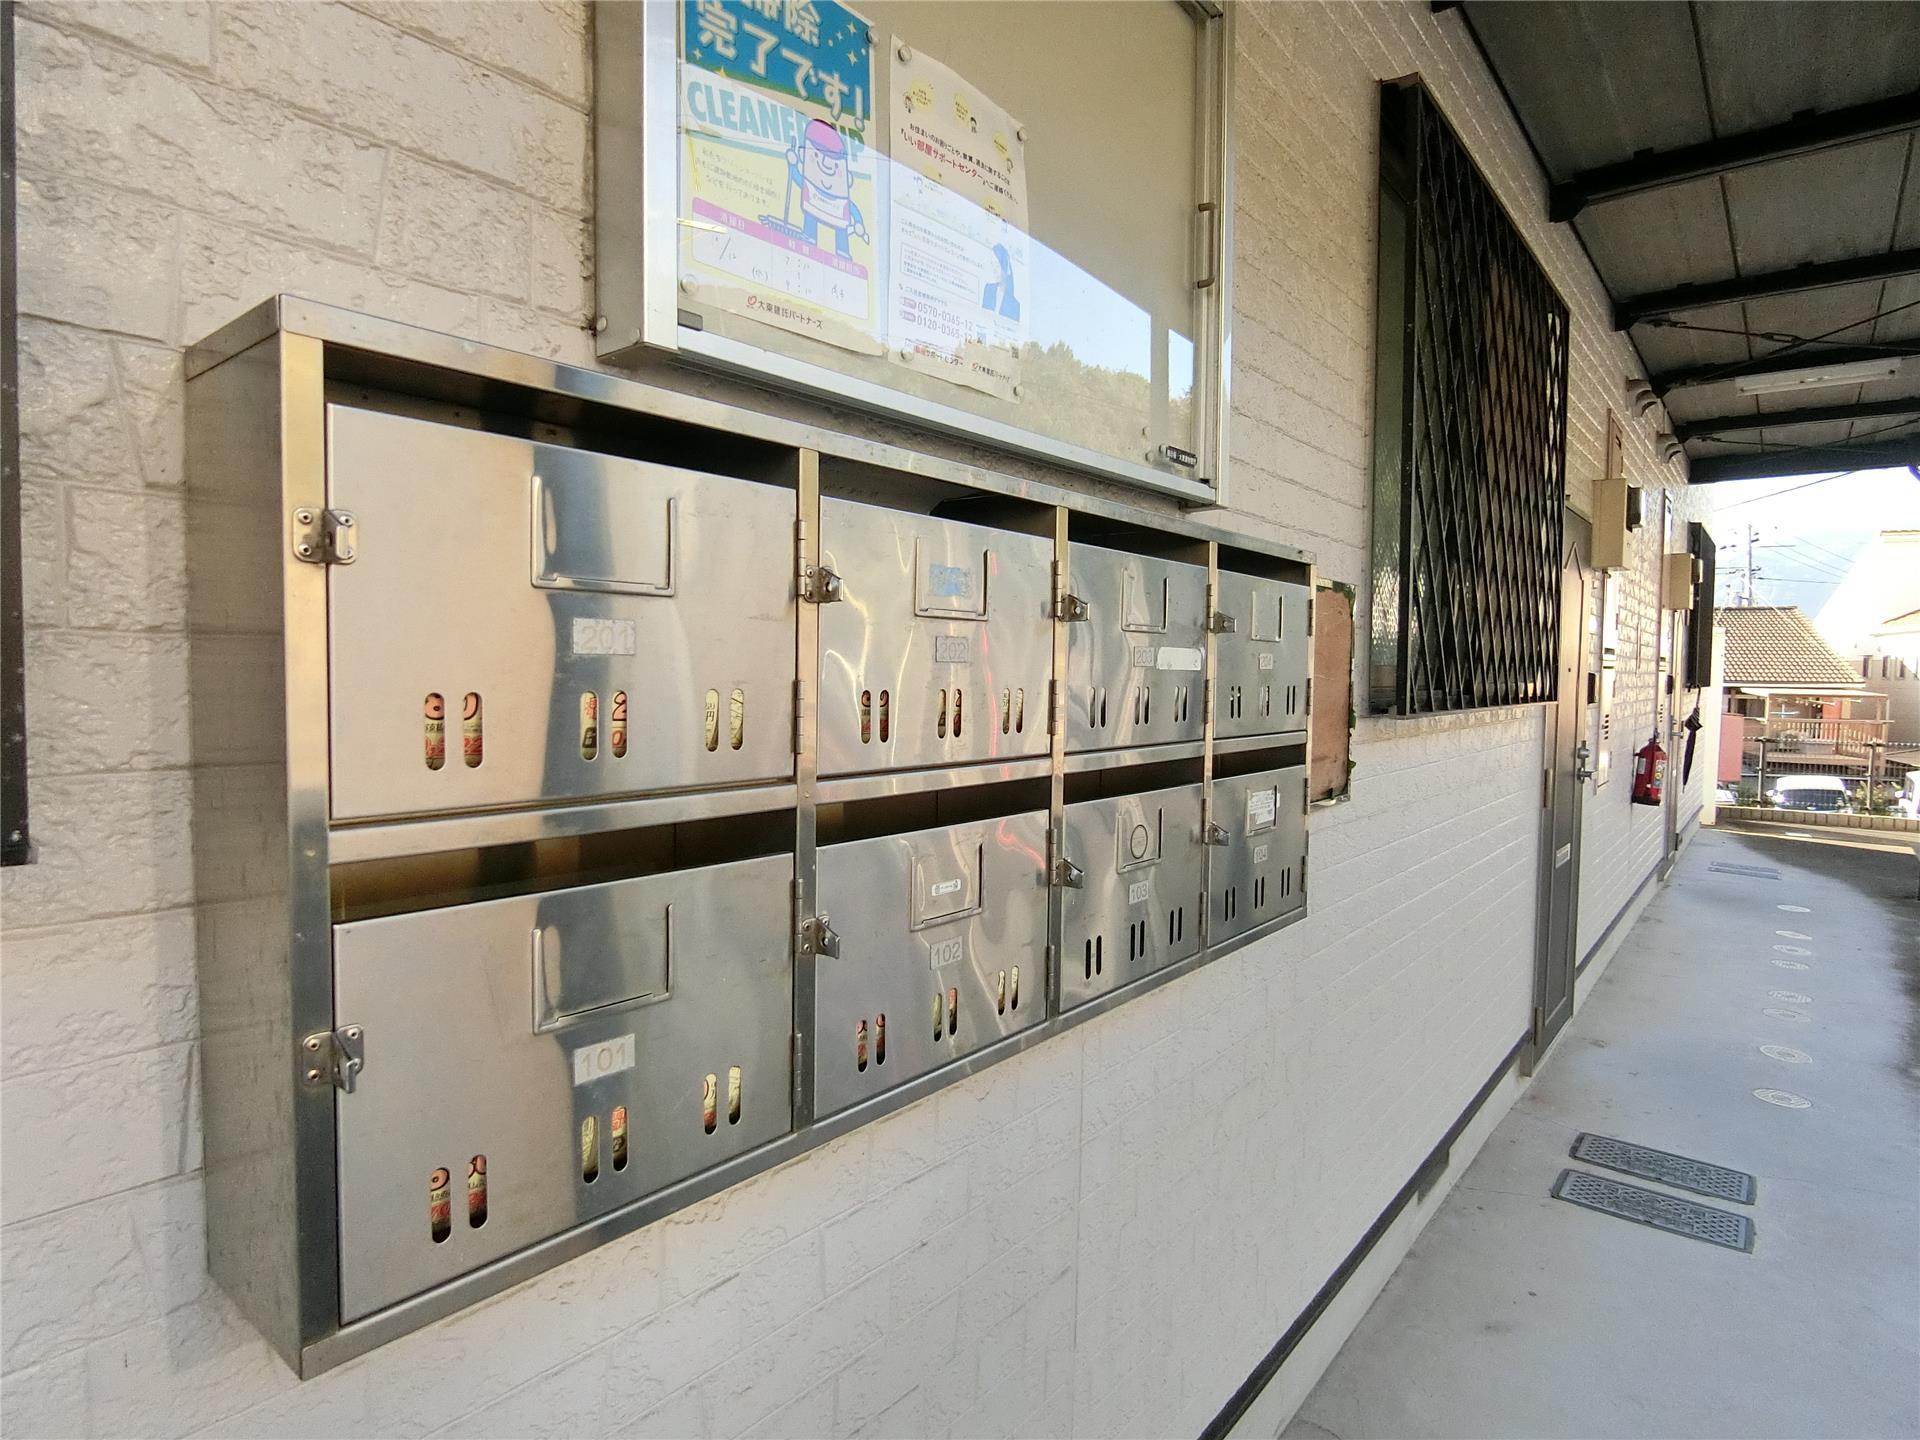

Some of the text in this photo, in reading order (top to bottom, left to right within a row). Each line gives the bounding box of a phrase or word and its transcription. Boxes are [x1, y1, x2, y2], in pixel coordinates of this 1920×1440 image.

[580, 625, 635, 651] 201
[940, 641, 967, 661] 202
[933, 942, 961, 966] 102
[581, 1042, 627, 1077] 101
